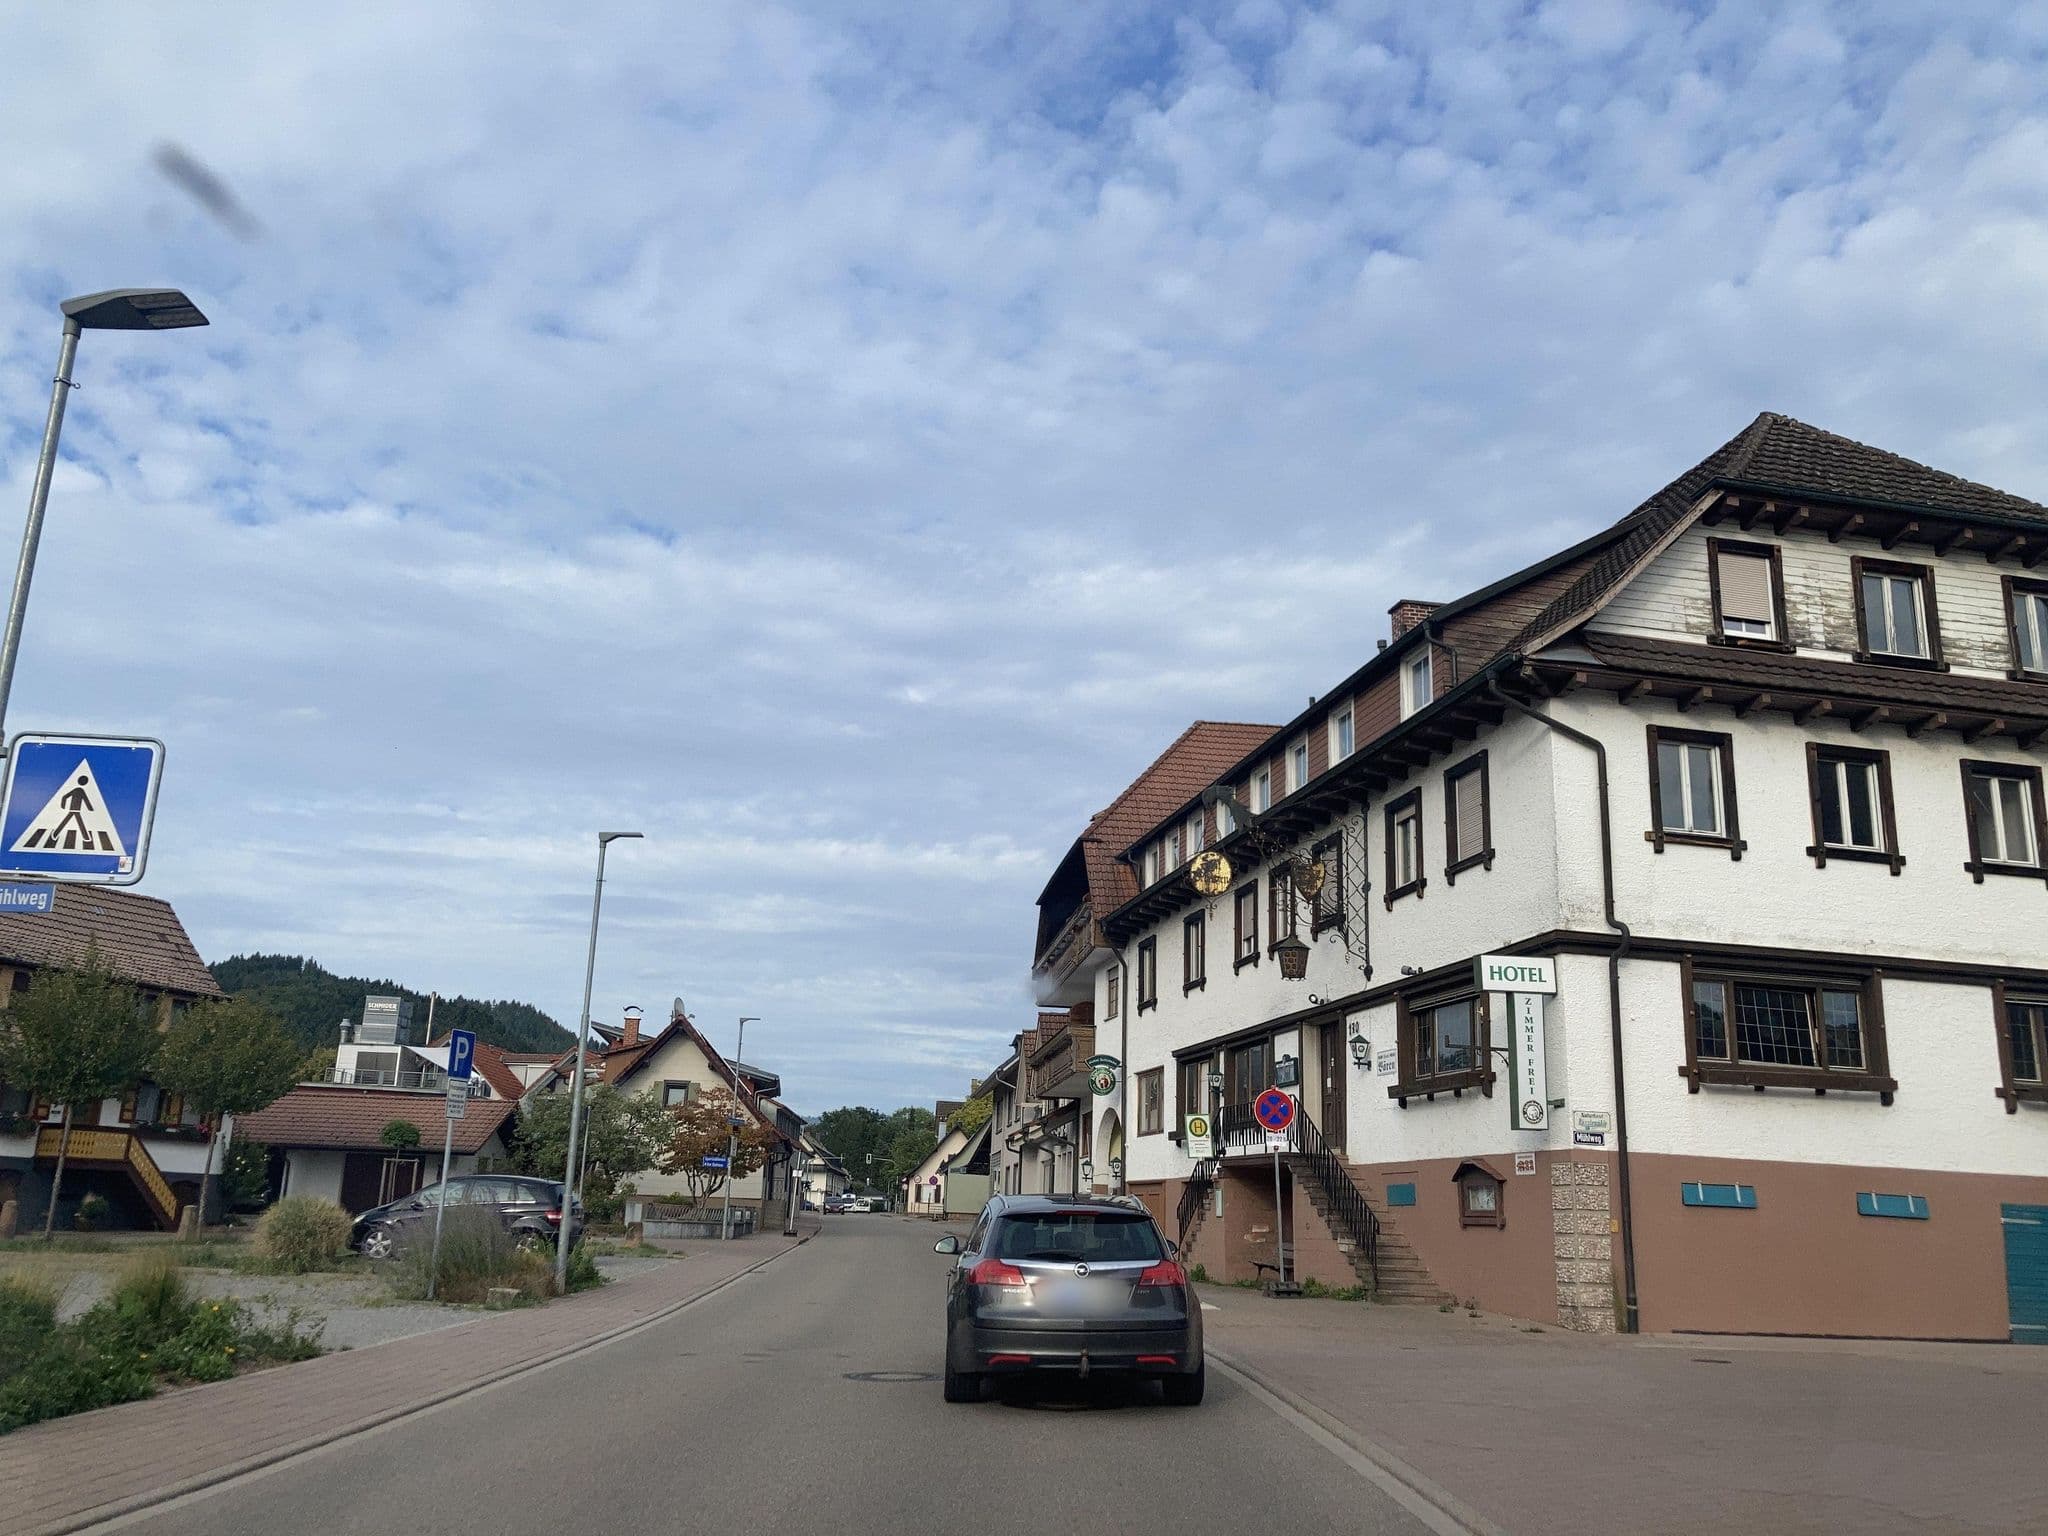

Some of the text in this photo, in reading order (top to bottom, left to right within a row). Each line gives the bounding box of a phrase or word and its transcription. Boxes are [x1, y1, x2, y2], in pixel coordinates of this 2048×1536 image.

[1489, 965, 1547, 983] HOTEL
[1524, 997, 1535, 1053] ZIMMER
[454, 1036, 469, 1072] P
[1194, 1121, 1203, 1133] H
